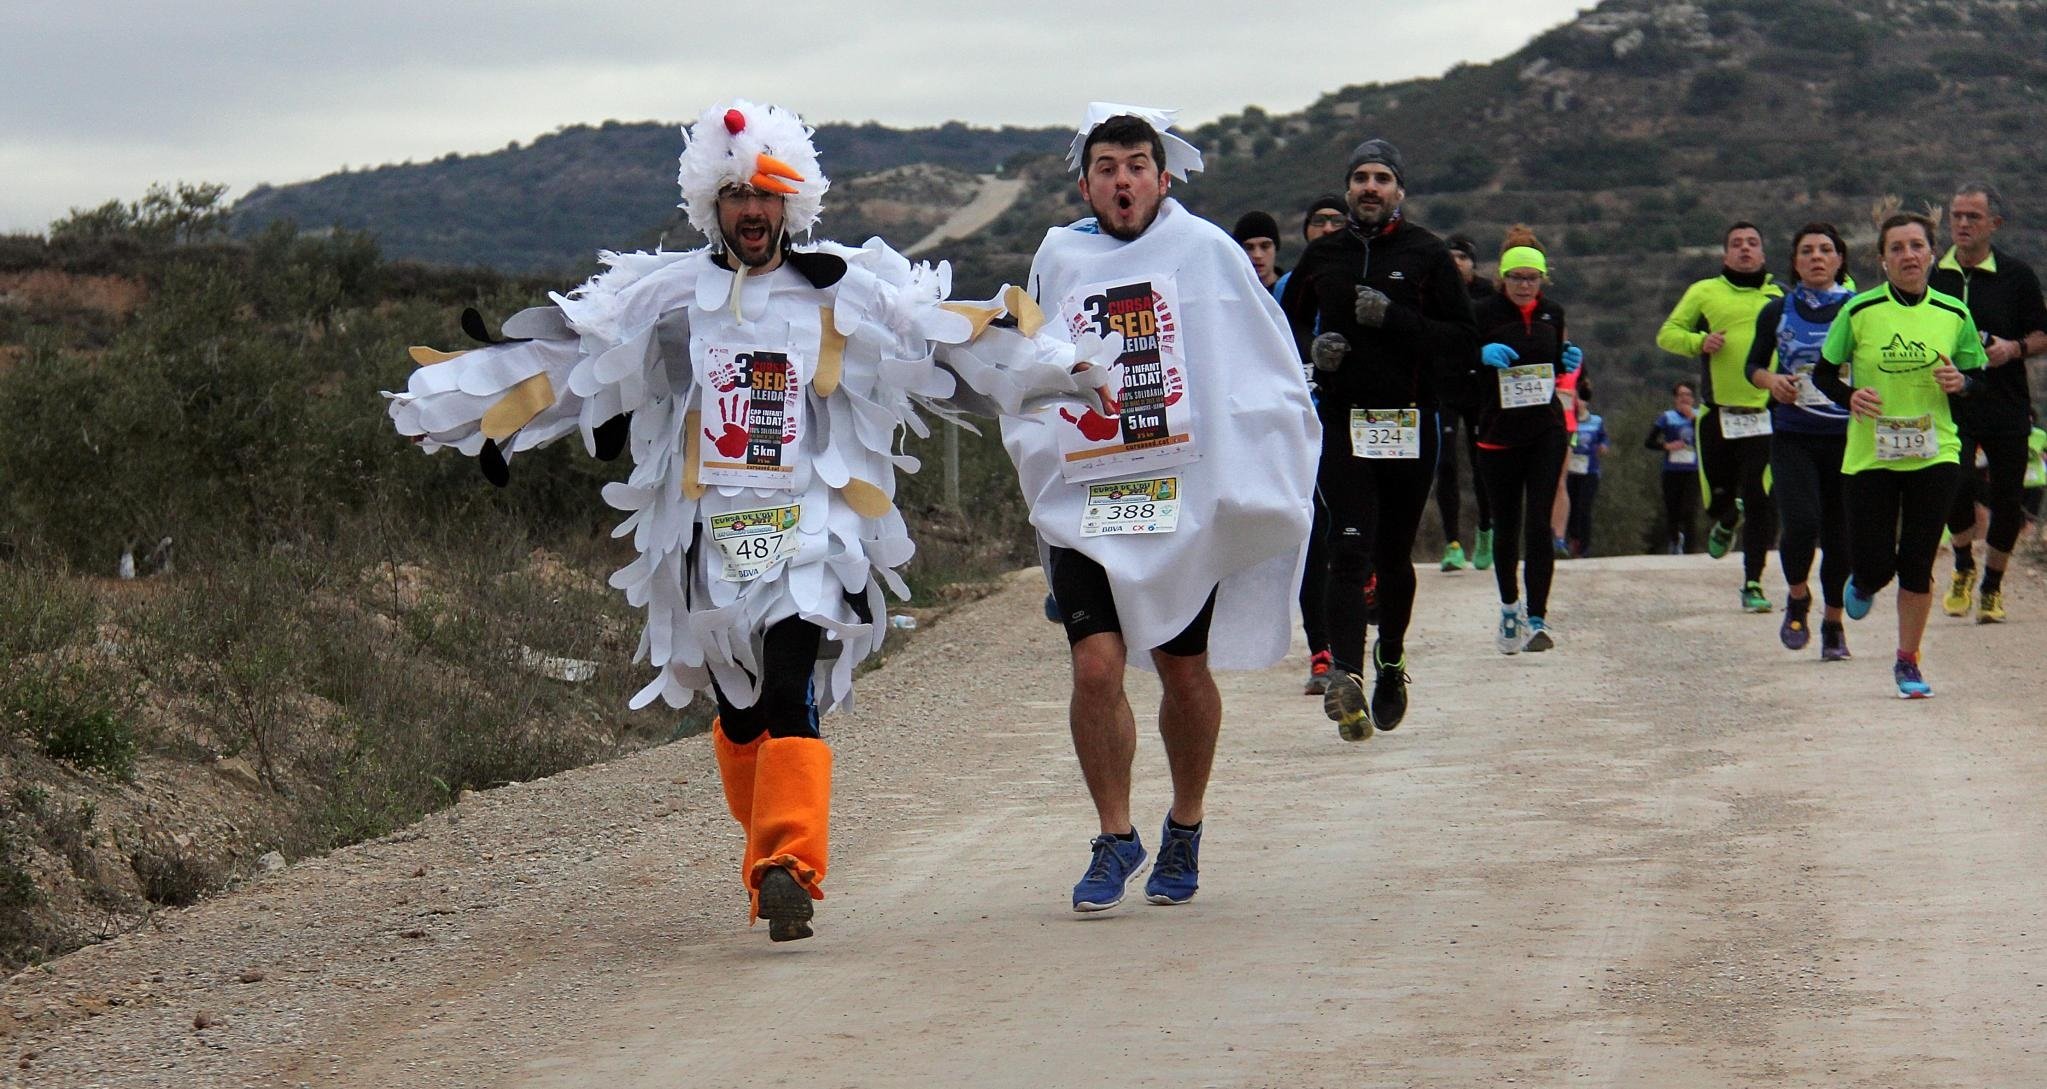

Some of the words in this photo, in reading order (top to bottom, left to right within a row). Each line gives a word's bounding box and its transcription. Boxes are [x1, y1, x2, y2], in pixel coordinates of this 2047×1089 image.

[1083, 294, 1108, 340] 3
[1108, 296, 1153, 316] CURSA
[1109, 310, 1157, 338] SED
[734, 353, 753, 389] 3
[1132, 362, 1160, 374] INFANT
[752, 371, 786, 391] SED
[1124, 371, 1161, 388] OLDAT
[751, 389, 785, 402] LLEIDA
[1515, 381, 1544, 396] 544
[750, 415, 783, 427] SOLDAT
[1128, 415, 1138, 430] 5
[1138, 414, 1159, 429] km
[1368, 428, 1402, 445] 324
[1893, 434, 1925, 449] 119
[752, 444, 760, 456] 5
[760, 445, 776, 457] km
[1093, 485, 1119, 494] CURSA
[714, 515, 740, 525] CURSA
[742, 513, 753, 521] DE
[1106, 503, 1155, 520] 388
[736, 534, 784, 560] 487
